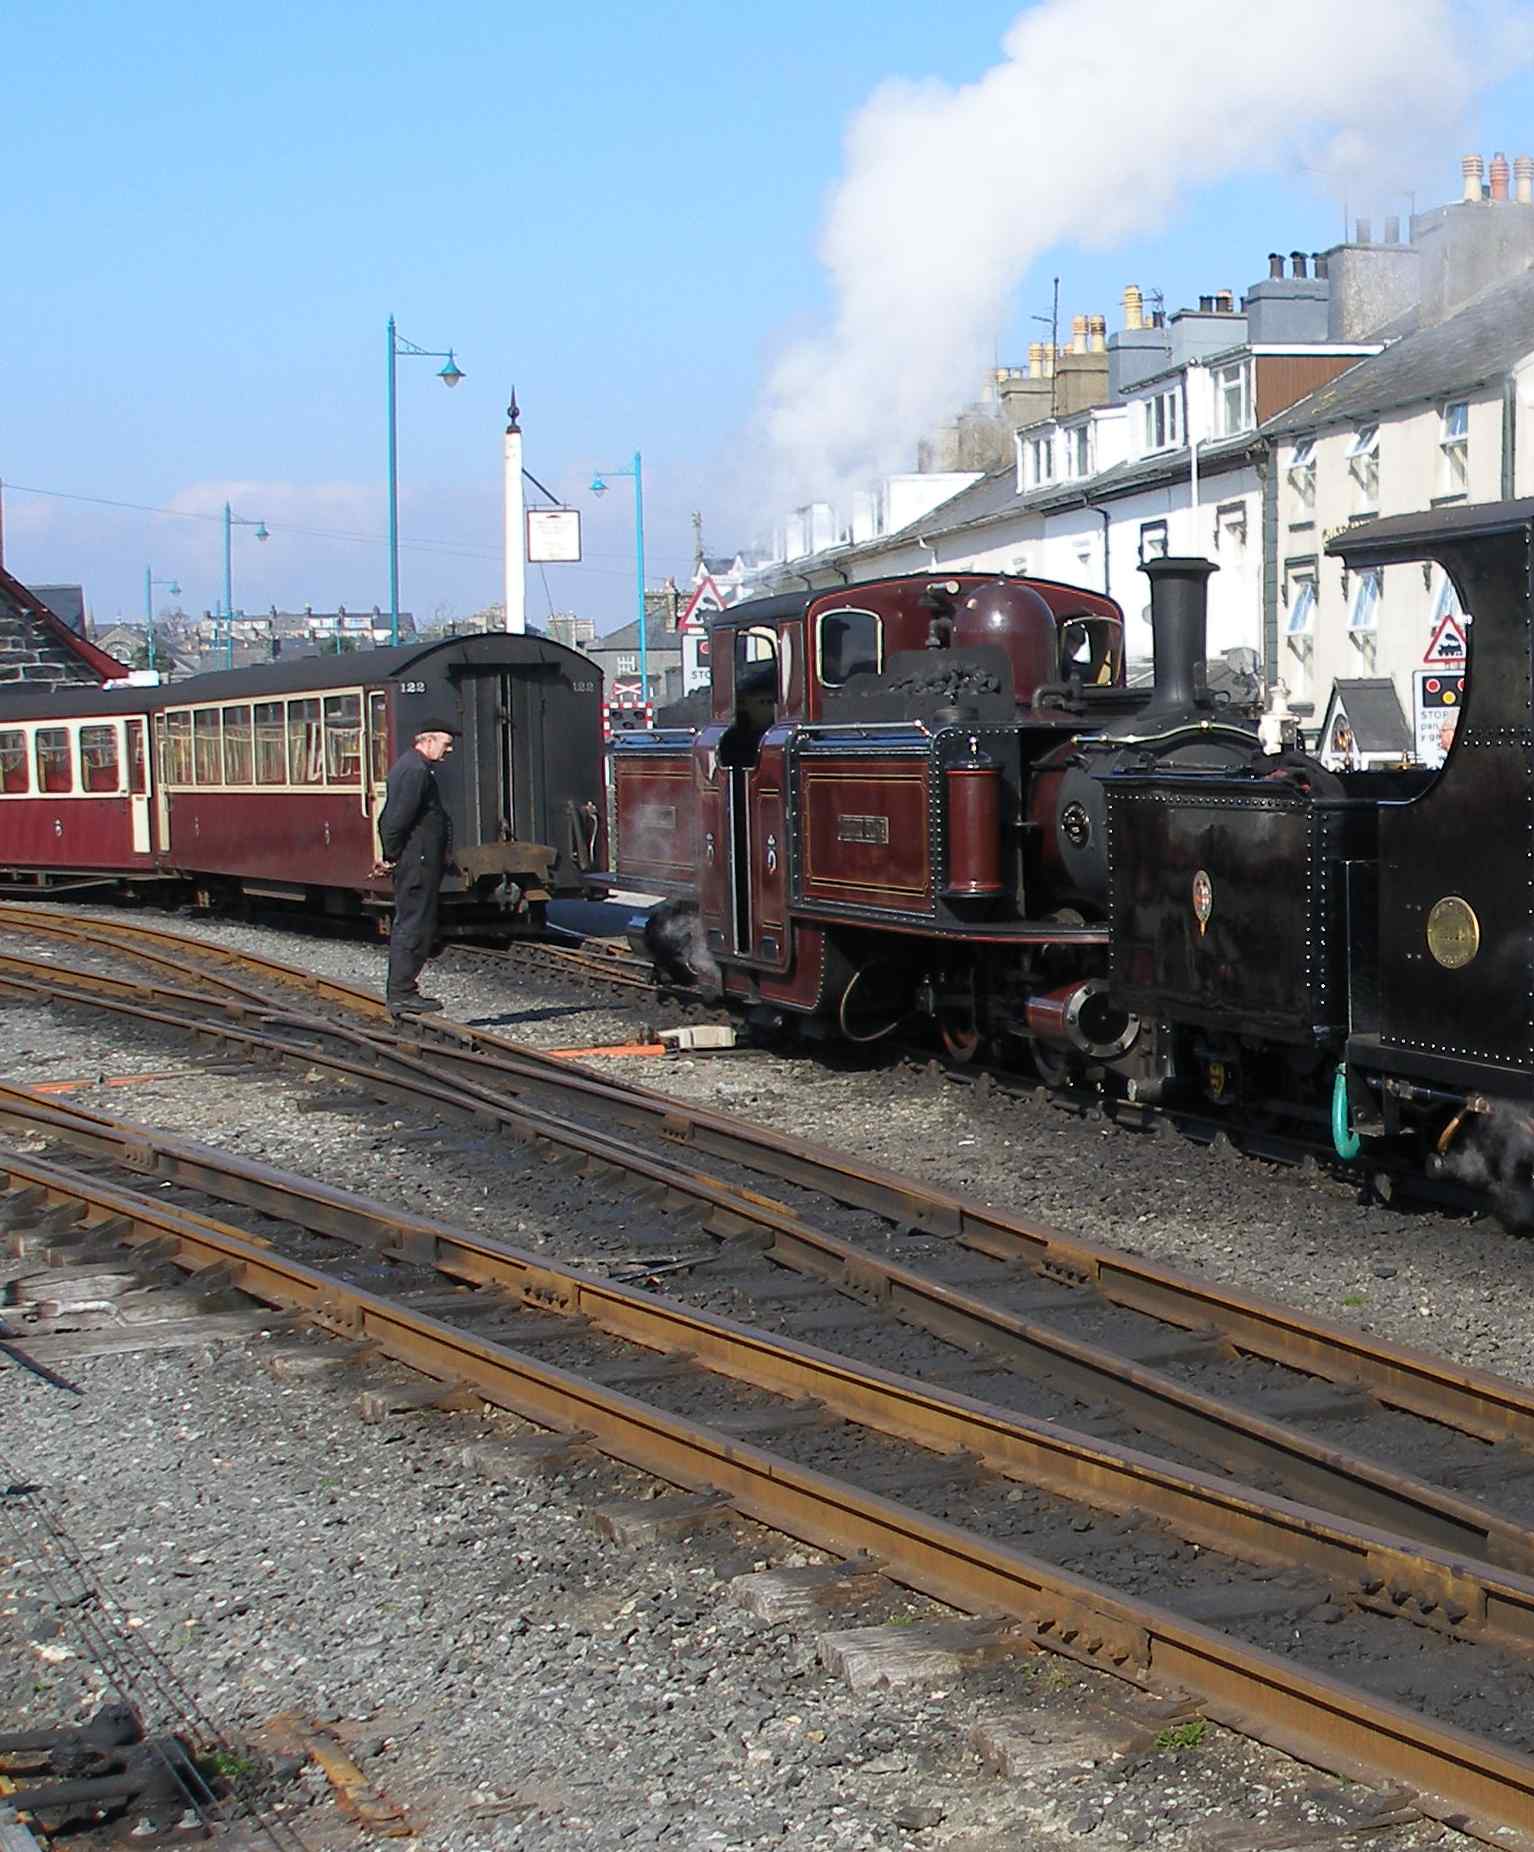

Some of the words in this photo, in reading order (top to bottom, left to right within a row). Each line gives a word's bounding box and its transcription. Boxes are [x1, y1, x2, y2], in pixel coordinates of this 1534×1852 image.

[400, 682, 426, 693] 122
[572, 682, 595, 693] 122
[1421, 711, 1449, 720] STOP
